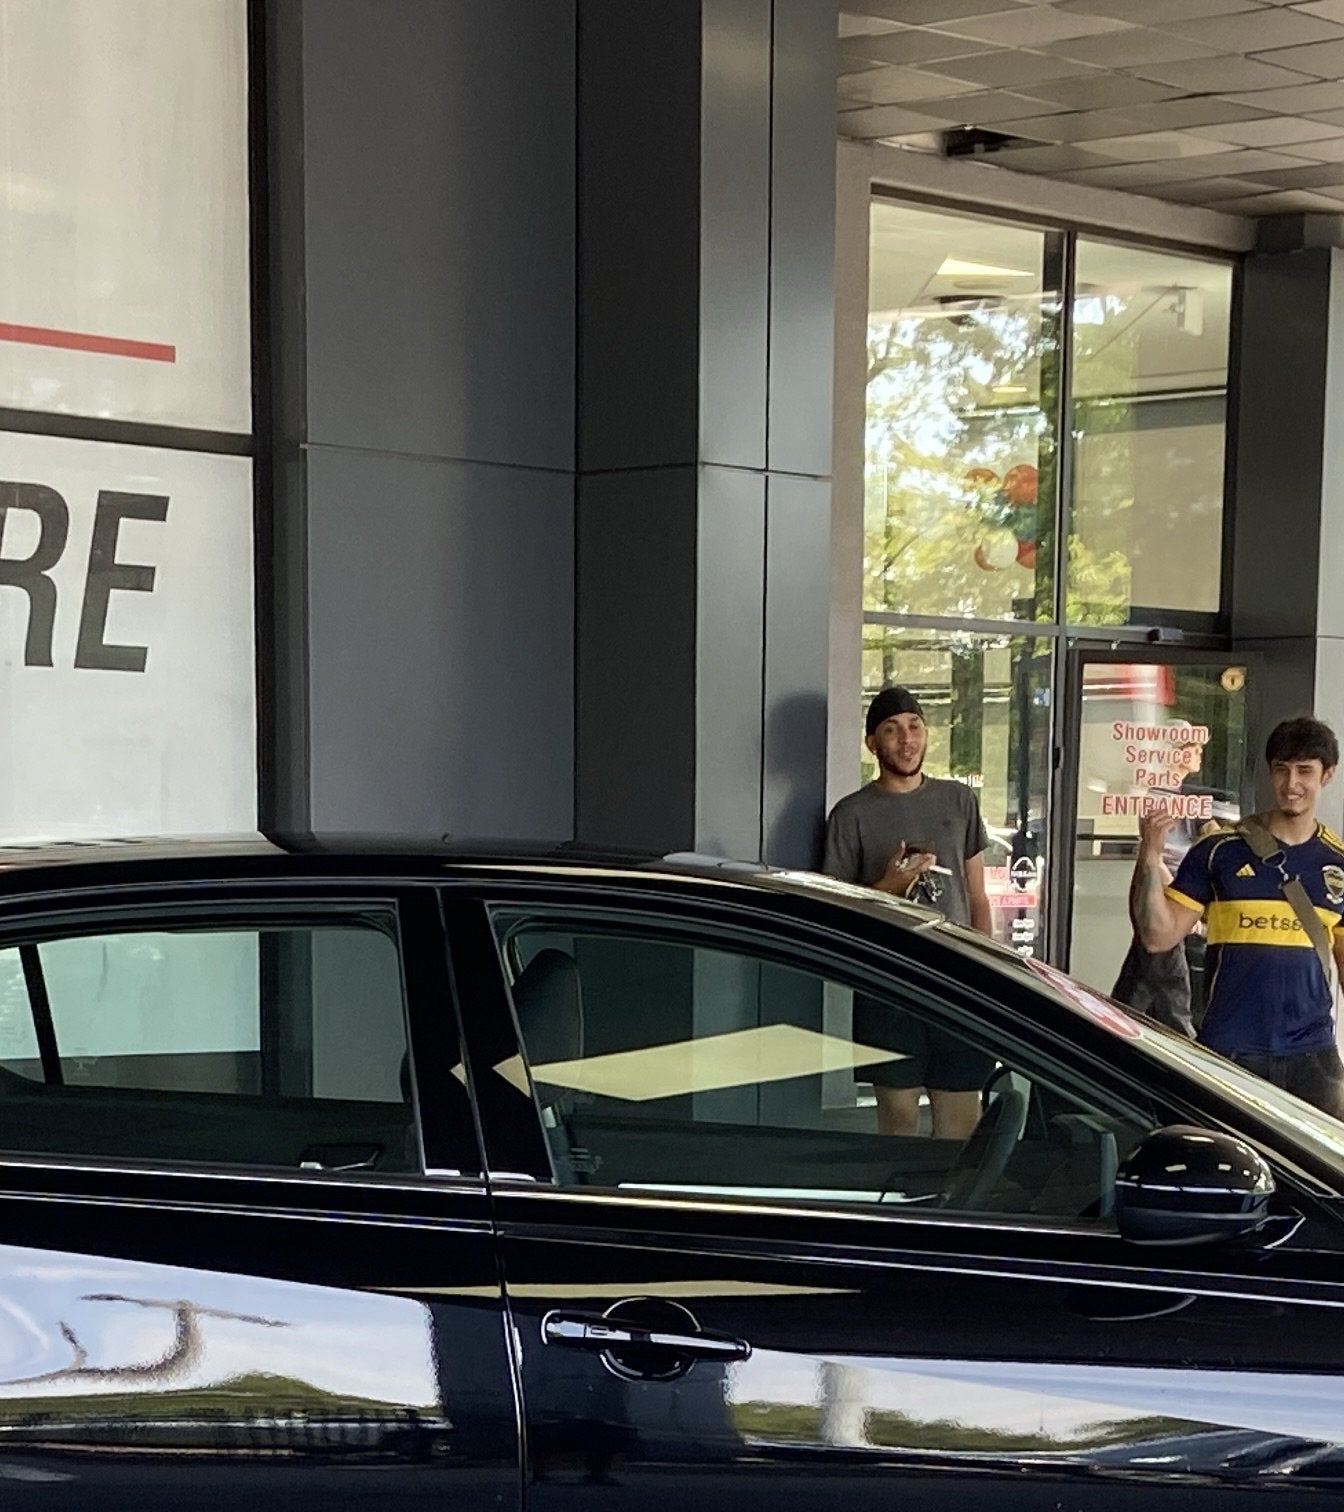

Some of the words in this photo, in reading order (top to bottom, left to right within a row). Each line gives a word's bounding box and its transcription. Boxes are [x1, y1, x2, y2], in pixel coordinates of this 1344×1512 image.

[1111, 721, 1209, 744] Showroom
[1124, 744, 1193, 765] Service
[1134, 767, 1182, 788] Parts
[1100, 794, 1213, 819] ENTRANCE
